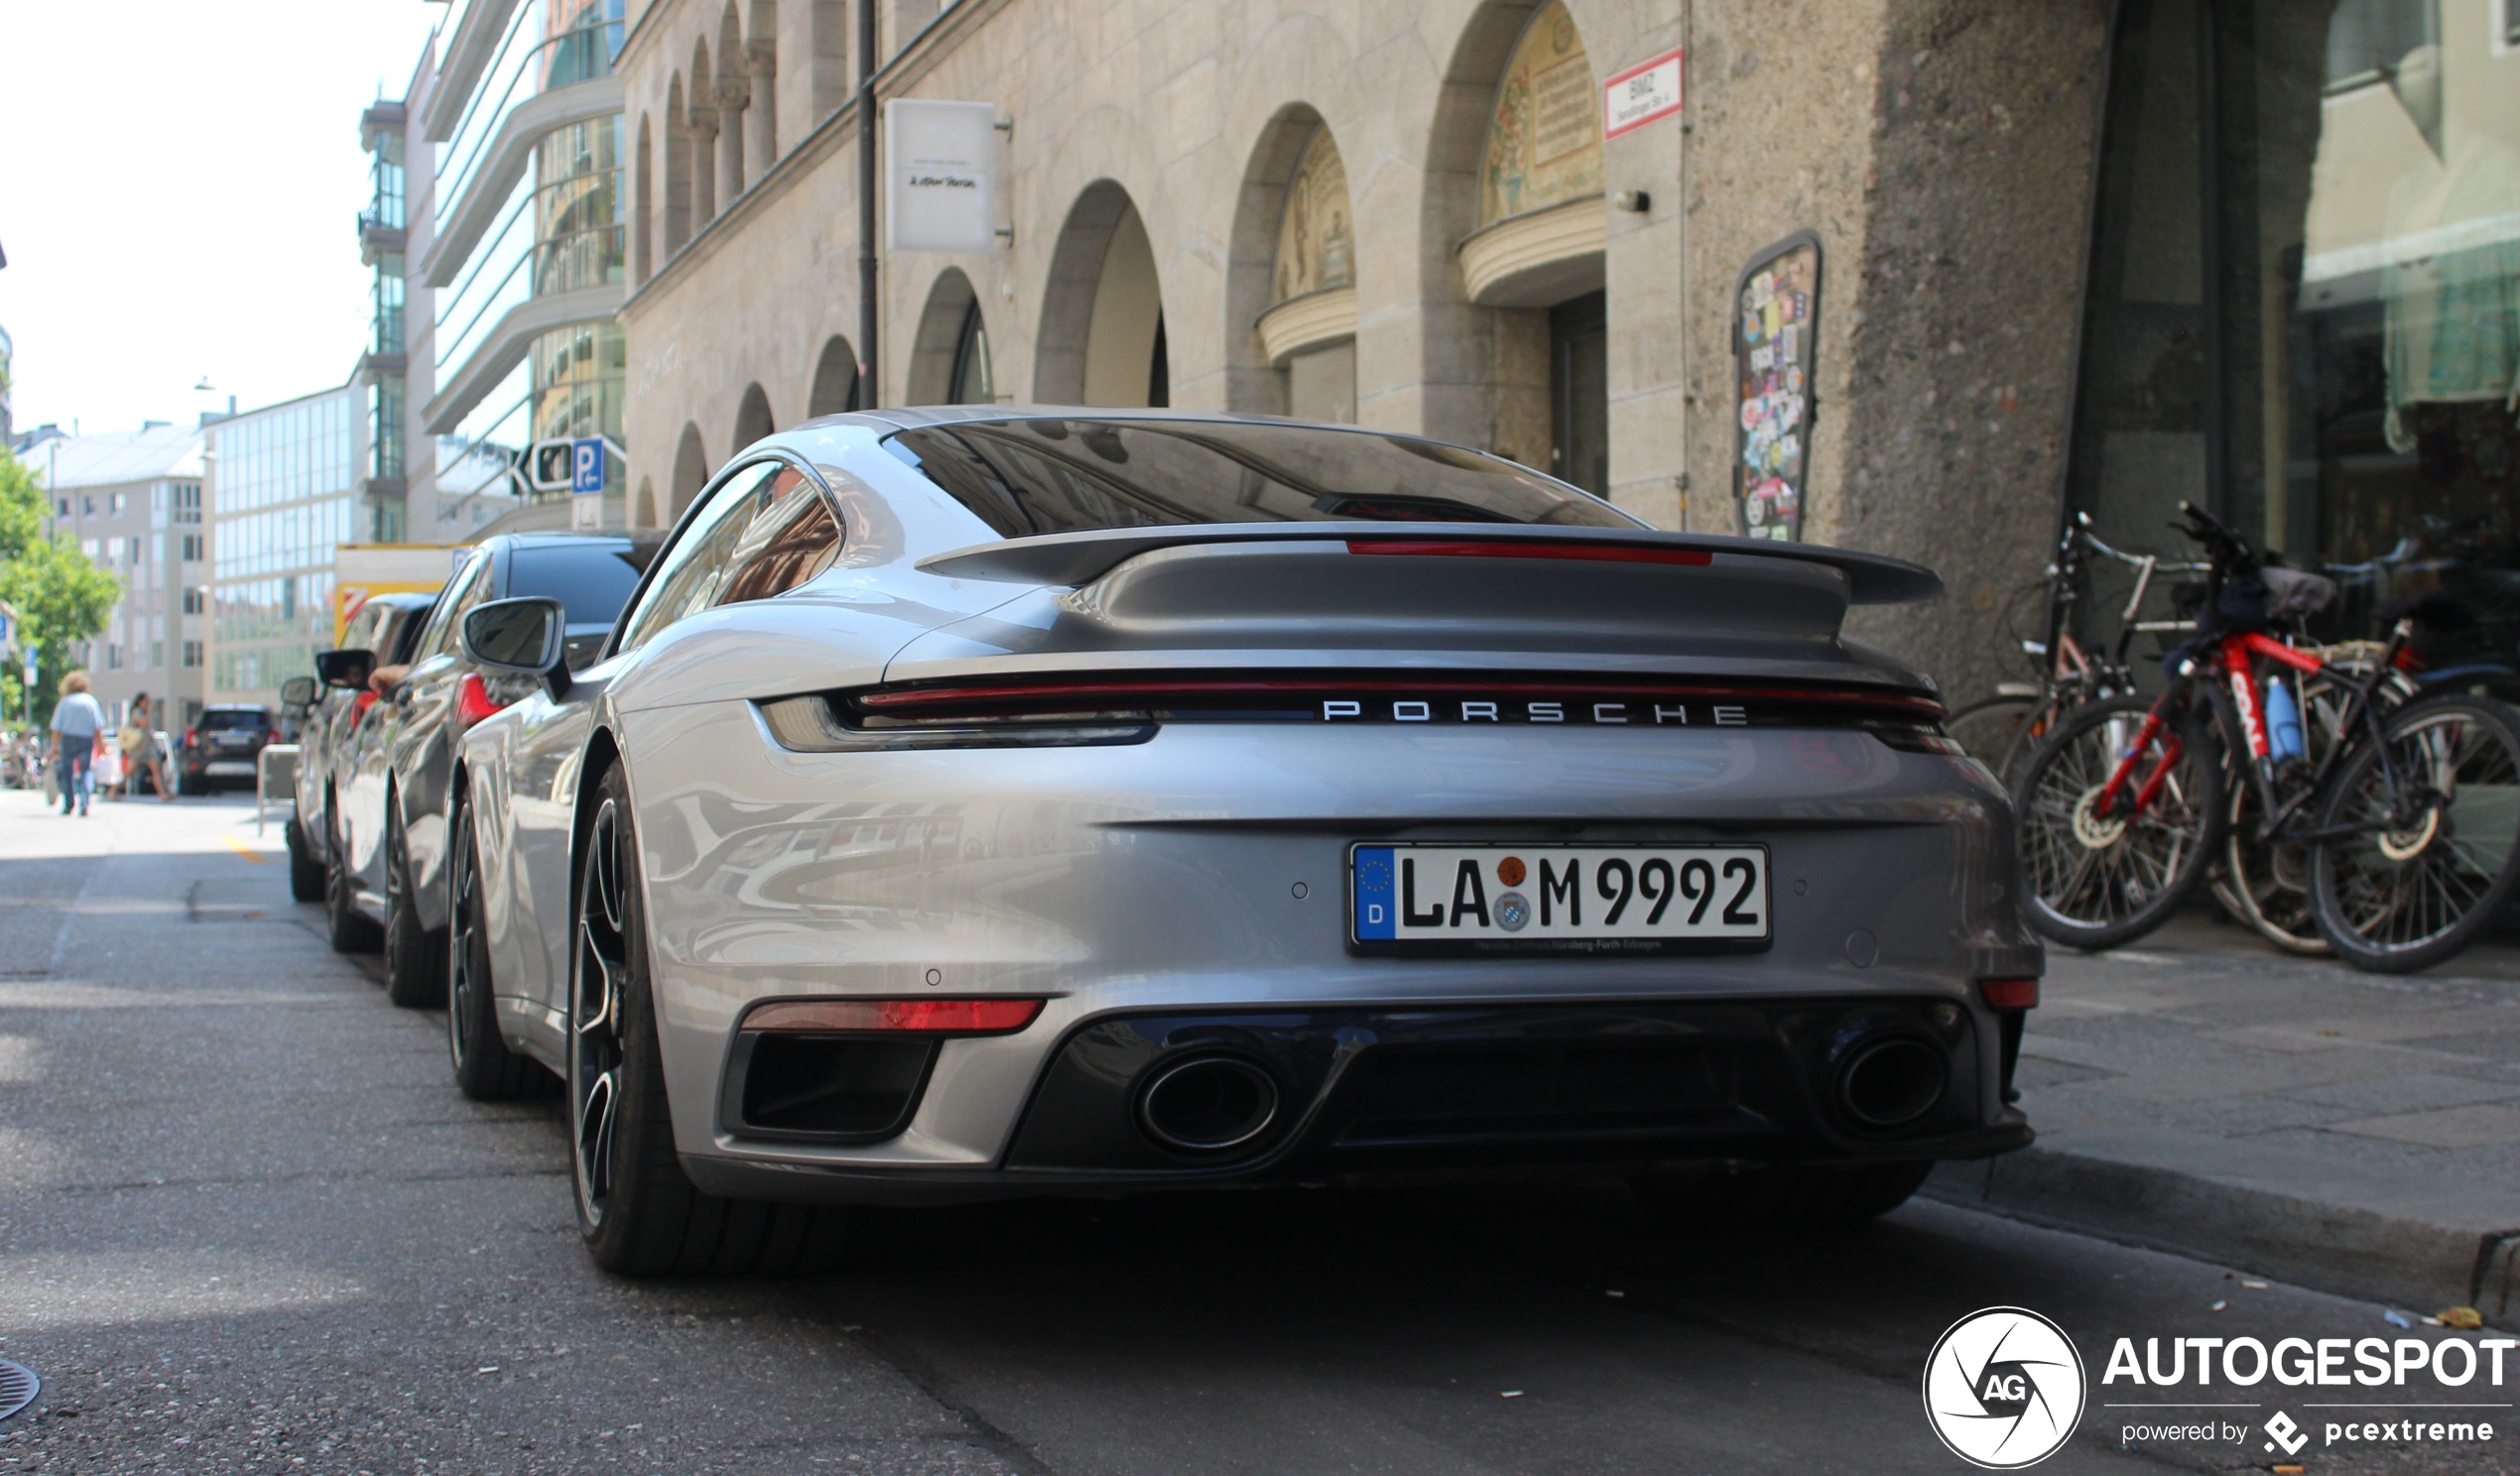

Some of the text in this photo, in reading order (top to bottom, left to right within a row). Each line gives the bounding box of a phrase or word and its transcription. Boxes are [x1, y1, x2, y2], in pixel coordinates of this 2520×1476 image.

[576, 444, 595, 488] P
[1323, 700, 1748, 725] PORSCHE
[1401, 857, 1758, 927] LA M 9992
[1368, 904, 1383, 923] D
